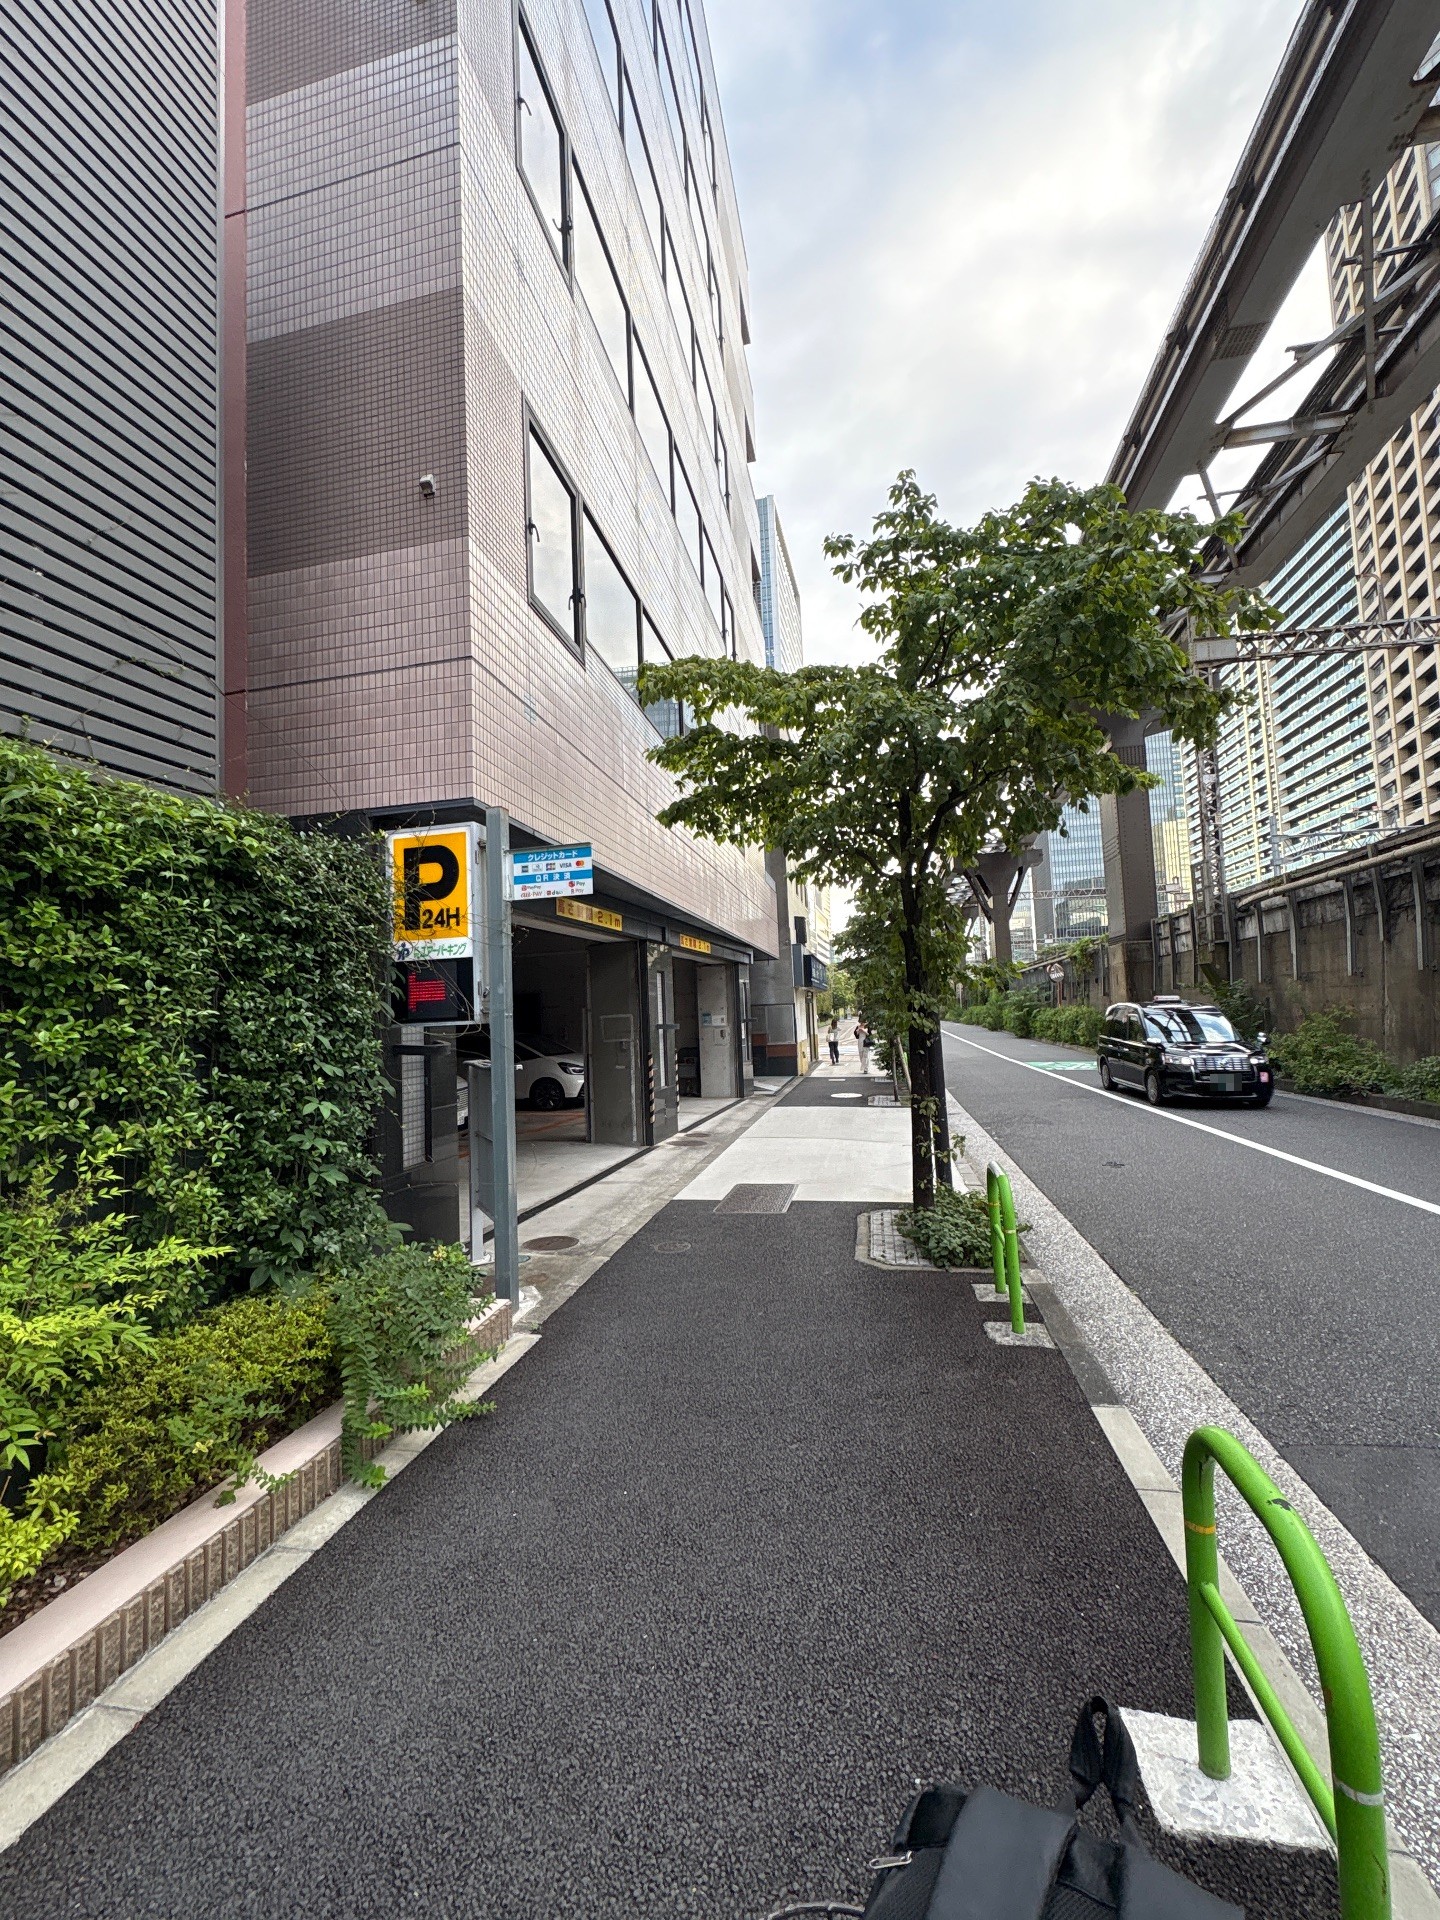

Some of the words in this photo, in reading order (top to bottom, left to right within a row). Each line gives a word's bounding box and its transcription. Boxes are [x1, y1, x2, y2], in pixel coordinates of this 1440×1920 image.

[528, 850, 578, 861] クレジットカード
[404, 845, 459, 931] P
[422, 907, 460, 929] 24H
